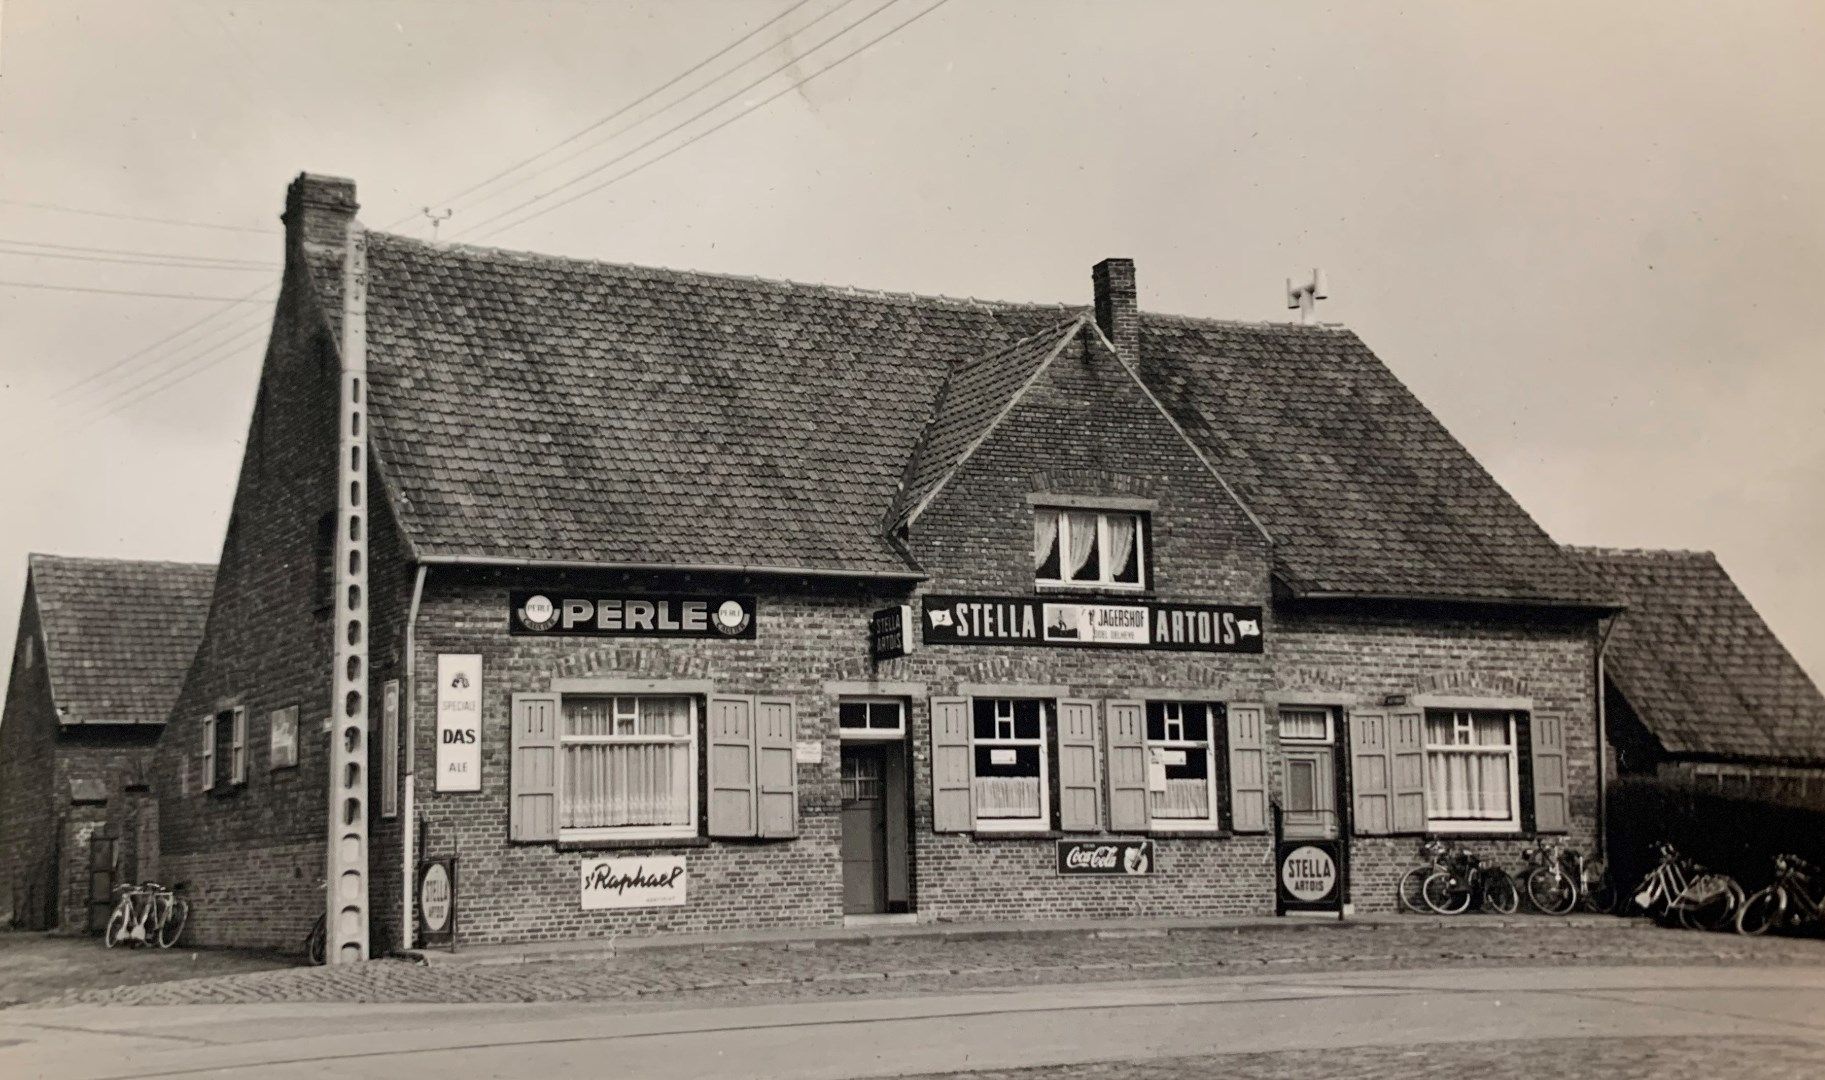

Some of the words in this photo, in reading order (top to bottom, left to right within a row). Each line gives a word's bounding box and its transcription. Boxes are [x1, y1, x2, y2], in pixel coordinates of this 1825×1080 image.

[562, 599, 707, 630] PERLE
[876, 614, 901, 633] STELLA
[956, 602, 1036, 638] STELLA
[1156, 609, 1235, 644] ARTOIS
[1098, 609, 1144, 628] JAGERSHOF
[443, 728, 476, 744] DAS
[449, 762, 468, 773] ALE
[1288, 859, 1331, 878] STELLA
[1294, 881, 1324, 891] ARTOIS
